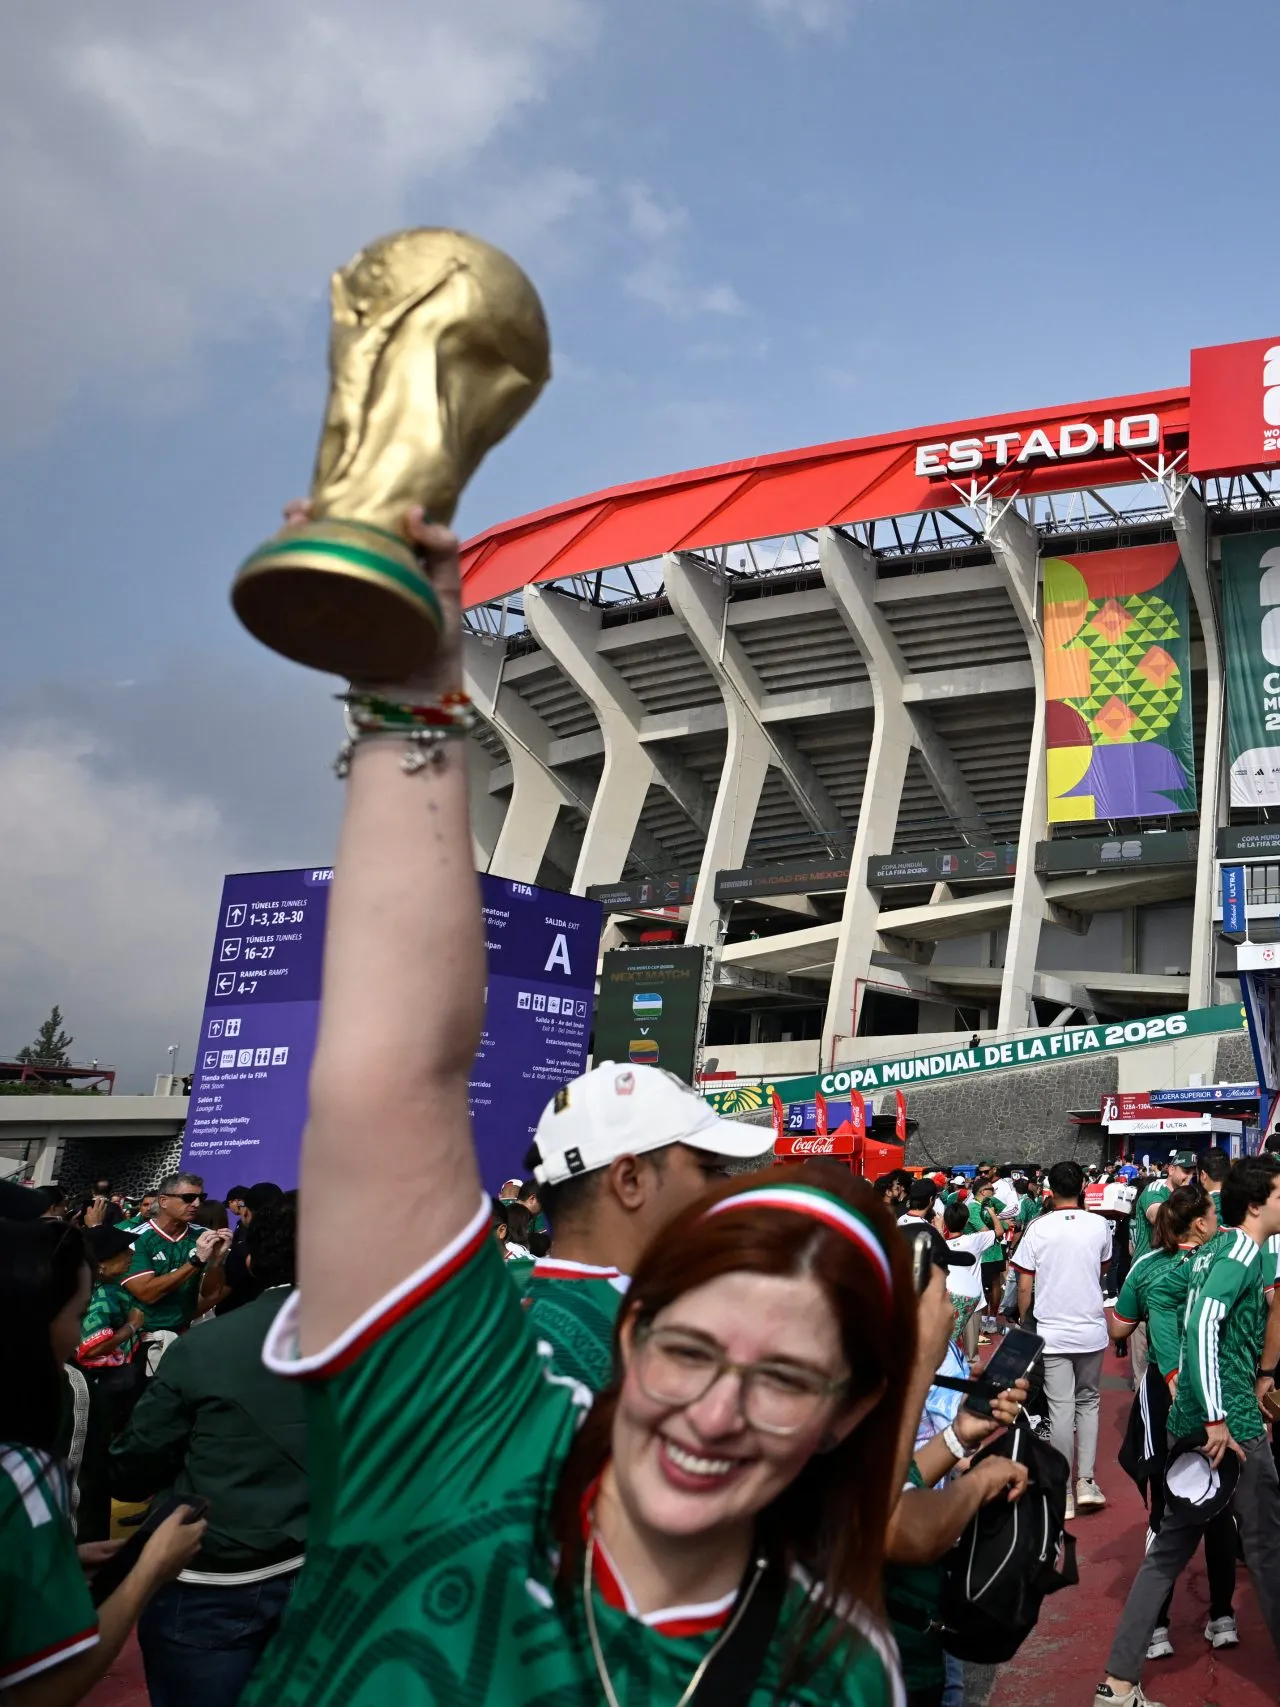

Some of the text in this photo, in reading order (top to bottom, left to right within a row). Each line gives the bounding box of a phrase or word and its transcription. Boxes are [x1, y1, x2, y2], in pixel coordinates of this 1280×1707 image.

[914, 412, 1160, 478] ESTADIO
[312, 870, 334, 881] FIFA
[512, 883, 532, 896] FIFA
[251, 899, 307, 909] TÚNELES TUNNELS
[487, 918, 507, 928] Bridge
[545, 917, 580, 930] SALIDA EXIT
[246, 933, 302, 943] TÚNELES TUNNELS
[544, 934, 572, 975] A
[240, 968, 288, 978] RAMPAS RAMPS
[610, 969, 690, 983] NEXT MATCH
[546, 1038, 582, 1048] Estacionamiento
[821, 1015, 1188, 1094] COPA MUNDIAL DE LA FIFA 2026
[532, 1065, 561, 1074] compartidos
[202, 1074, 220, 1082] Tienda
[1180, 1091, 1211, 1099] SUPERIOR
[220, 1117, 250, 1125] hospitality
[790, 1115, 803, 1128] 29
[791, 1136, 835, 1154] Coca-Cola
